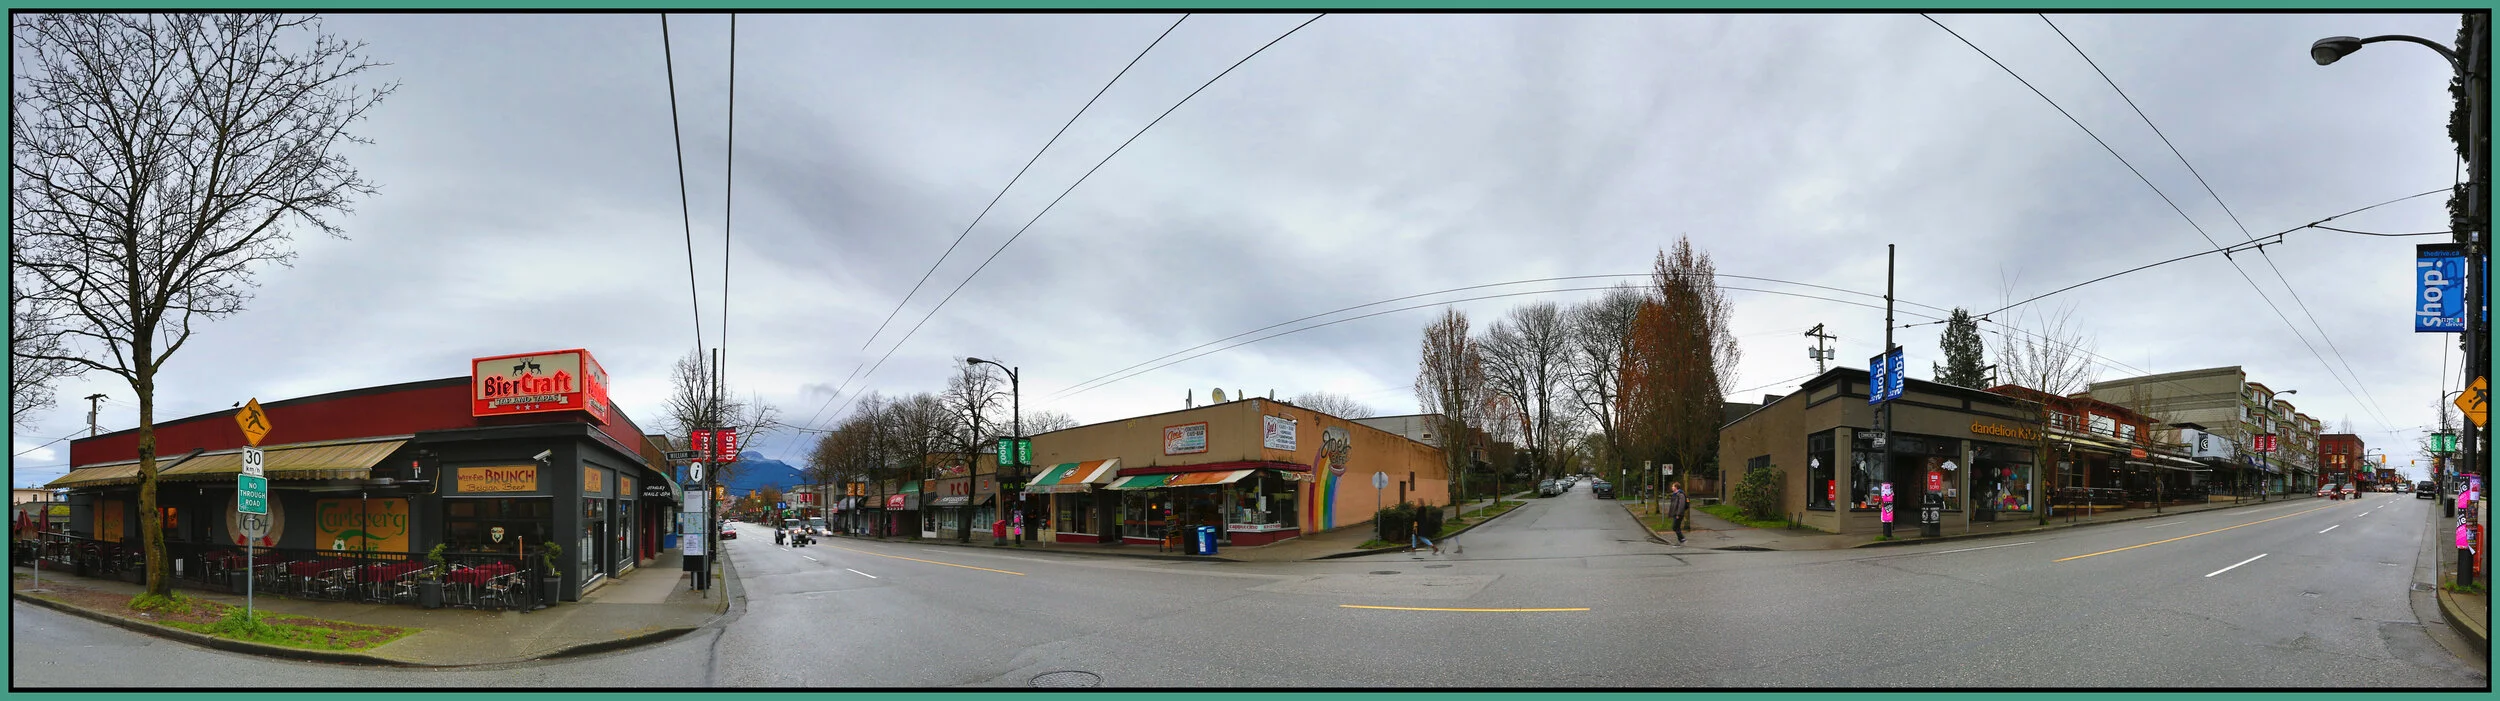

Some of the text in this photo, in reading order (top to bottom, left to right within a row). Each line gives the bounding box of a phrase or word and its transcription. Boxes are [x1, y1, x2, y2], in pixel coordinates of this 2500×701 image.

[2416, 261, 2449, 327] shop!
[484, 369, 572, 396] BierCraft
[1971, 420, 2016, 437] dandelion
[998, 441, 1007, 464] cook!
[1321, 430, 1351, 458] Joe's
[245, 450, 261, 466] 30
[485, 469, 535, 484] BRUNCH
[240, 489, 266, 499] THROUGH
[246, 499, 261, 507] ROAD
